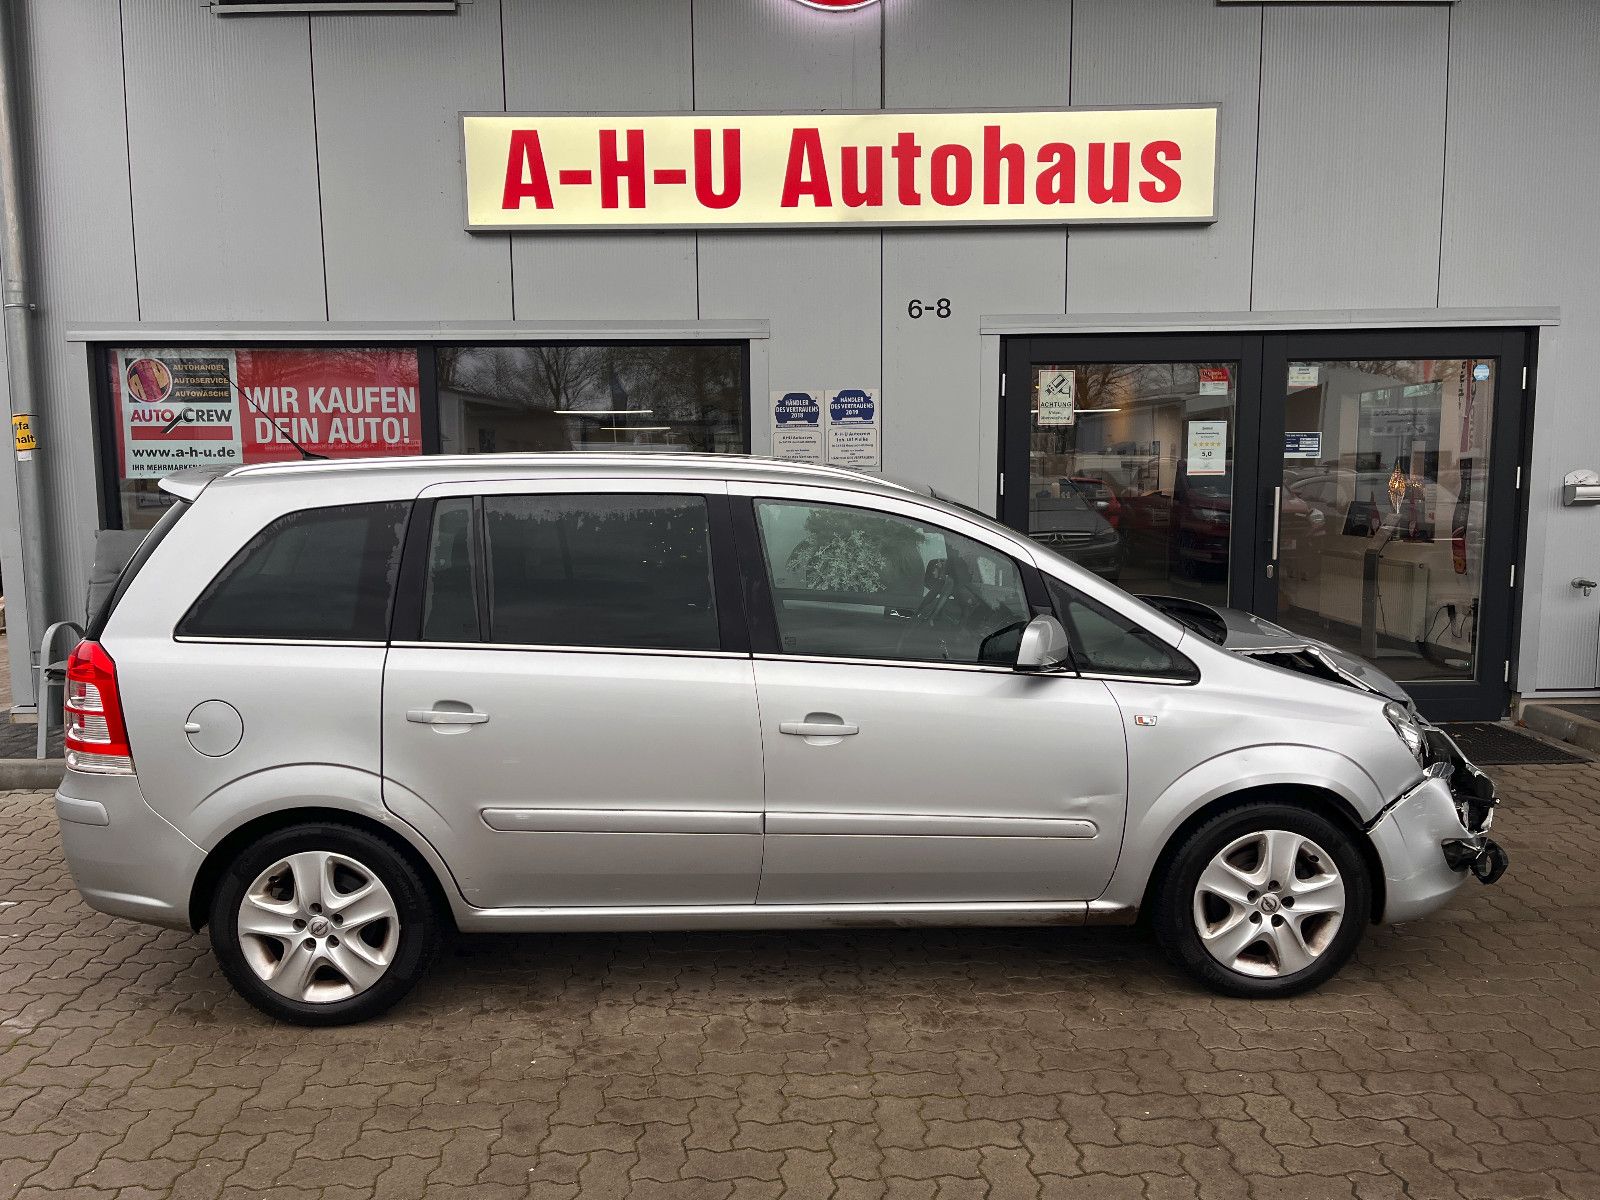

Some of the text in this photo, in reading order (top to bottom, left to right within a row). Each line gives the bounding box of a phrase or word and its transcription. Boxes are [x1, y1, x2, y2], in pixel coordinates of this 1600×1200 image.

[502, 125, 1183, 209] A-H-U Autohaus
[907, 298, 952, 320] 6-8
[244, 386, 416, 413] WIR KAUFEN
[254, 417, 410, 444] DEIN AUTO!
[132, 446, 236, 458] www.a-h-u.de
